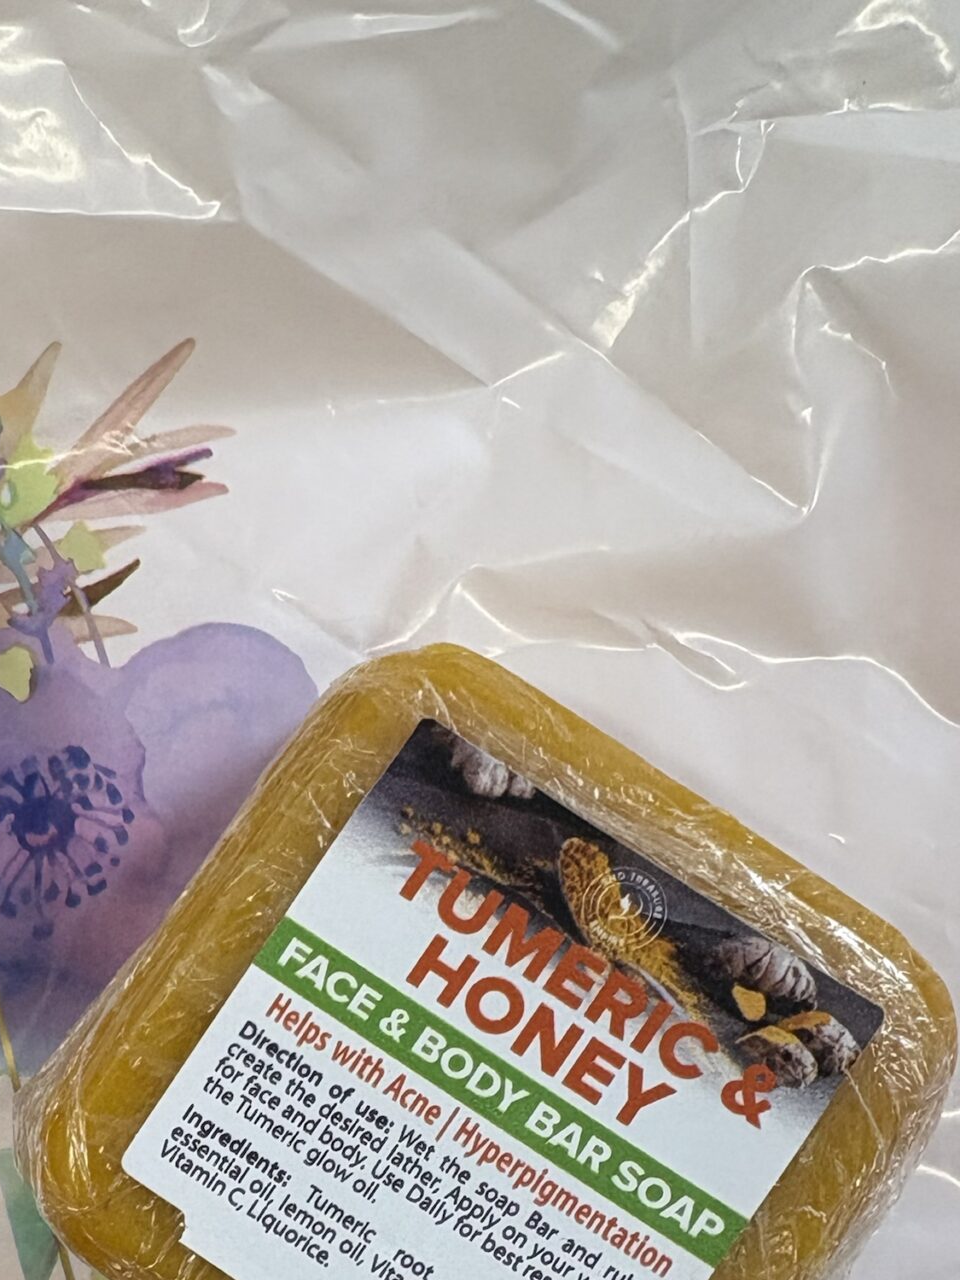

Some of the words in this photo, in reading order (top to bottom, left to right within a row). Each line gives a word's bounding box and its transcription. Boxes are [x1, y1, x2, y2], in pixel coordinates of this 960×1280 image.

[277, 937, 383, 1020] FACE
[379, 1008, 409, 1042] &
[411, 1026, 530, 1112] BODY
[524, 1101, 611, 1173] BAR
[611, 1160, 724, 1237] SOAP
[400, 839, 720, 1078] TUMERIC
[720, 1062, 778, 1126] &
[407, 934, 674, 1125] HONEY
[160, 1139, 226, 1196] Vitamin
[228, 1187, 245, 1211] C,
[170, 1126, 250, 1184] essential
[249, 1179, 276, 1207] oil,
[278, 1194, 336, 1244] lemon
[339, 1239, 366, 1266] oil,
[182, 1103, 291, 1188] Ingredients:
[306, 1184, 376, 1244] Tumeric
[203, 1076, 233, 1105] the
[236, 1094, 306, 1153] Tumeric
[303, 1148, 353, 1182] glow
[352, 1179, 379, 1204] oil.
[214, 1056, 244, 1083] for
[242, 1075, 280, 1110] face
[281, 1104, 321, 1135] and
[317, 1124, 367, 1170] body.
[371, 1159, 404, 1193] Use
[405, 1183, 454, 1225] Daily
[452, 1215, 482, 1242] for
[480, 1233, 523, 1272] best
[227, 1043, 282, 1085] create
[285, 1078, 316, 1108] the
[318, 1102, 388, 1153] desired
[386, 1143, 442, 1194] lather,
[441, 1185, 505, 1236] Apply
[502, 1225, 527, 1248] on
[526, 1243, 575, 1277] your
[238, 1020, 323, 1087] Direction
[328, 1084, 355, 1104] of
[354, 1100, 394, 1134] use:
[398, 1124, 435, 1161] Wet
[439, 1155, 471, 1185] the
[474, 1181, 519, 1217] soap
[524, 1210, 559, 1240] Bar
[561, 1238, 602, 1269] and
[266, 992, 332, 1051] Helps
[331, 1040, 384, 1088] with
[383, 1073, 441, 1125] Acne
[453, 1117, 672, 1277] Hyperpigmentation
